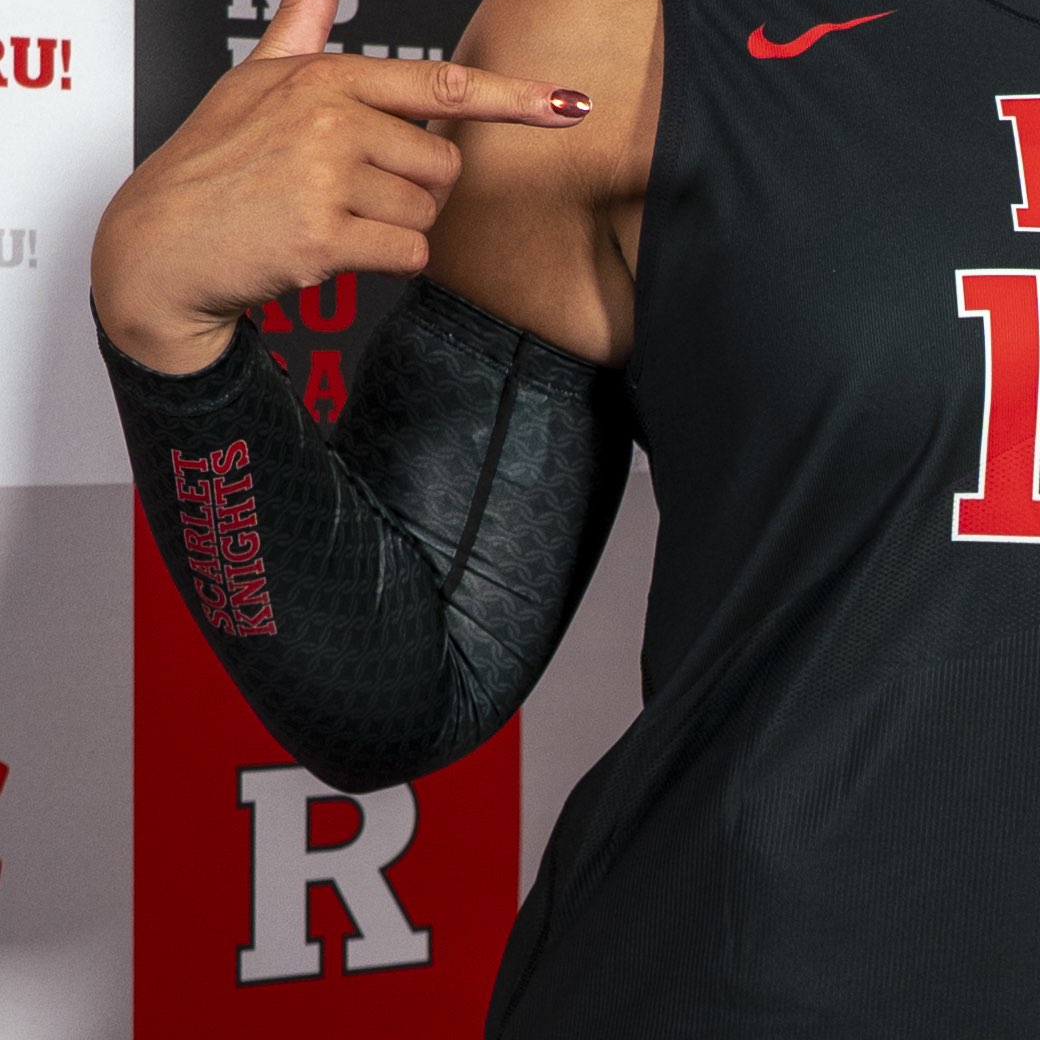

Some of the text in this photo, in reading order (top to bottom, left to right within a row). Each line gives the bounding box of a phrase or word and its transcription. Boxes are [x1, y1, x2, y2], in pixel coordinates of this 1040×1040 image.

[0, 36, 72, 91] U!
[245, 272, 357, 333] U
[171, 448, 236, 636] SCARLET
[210, 439, 278, 637] KNIGHTS
[236, 763, 433, 987] R
